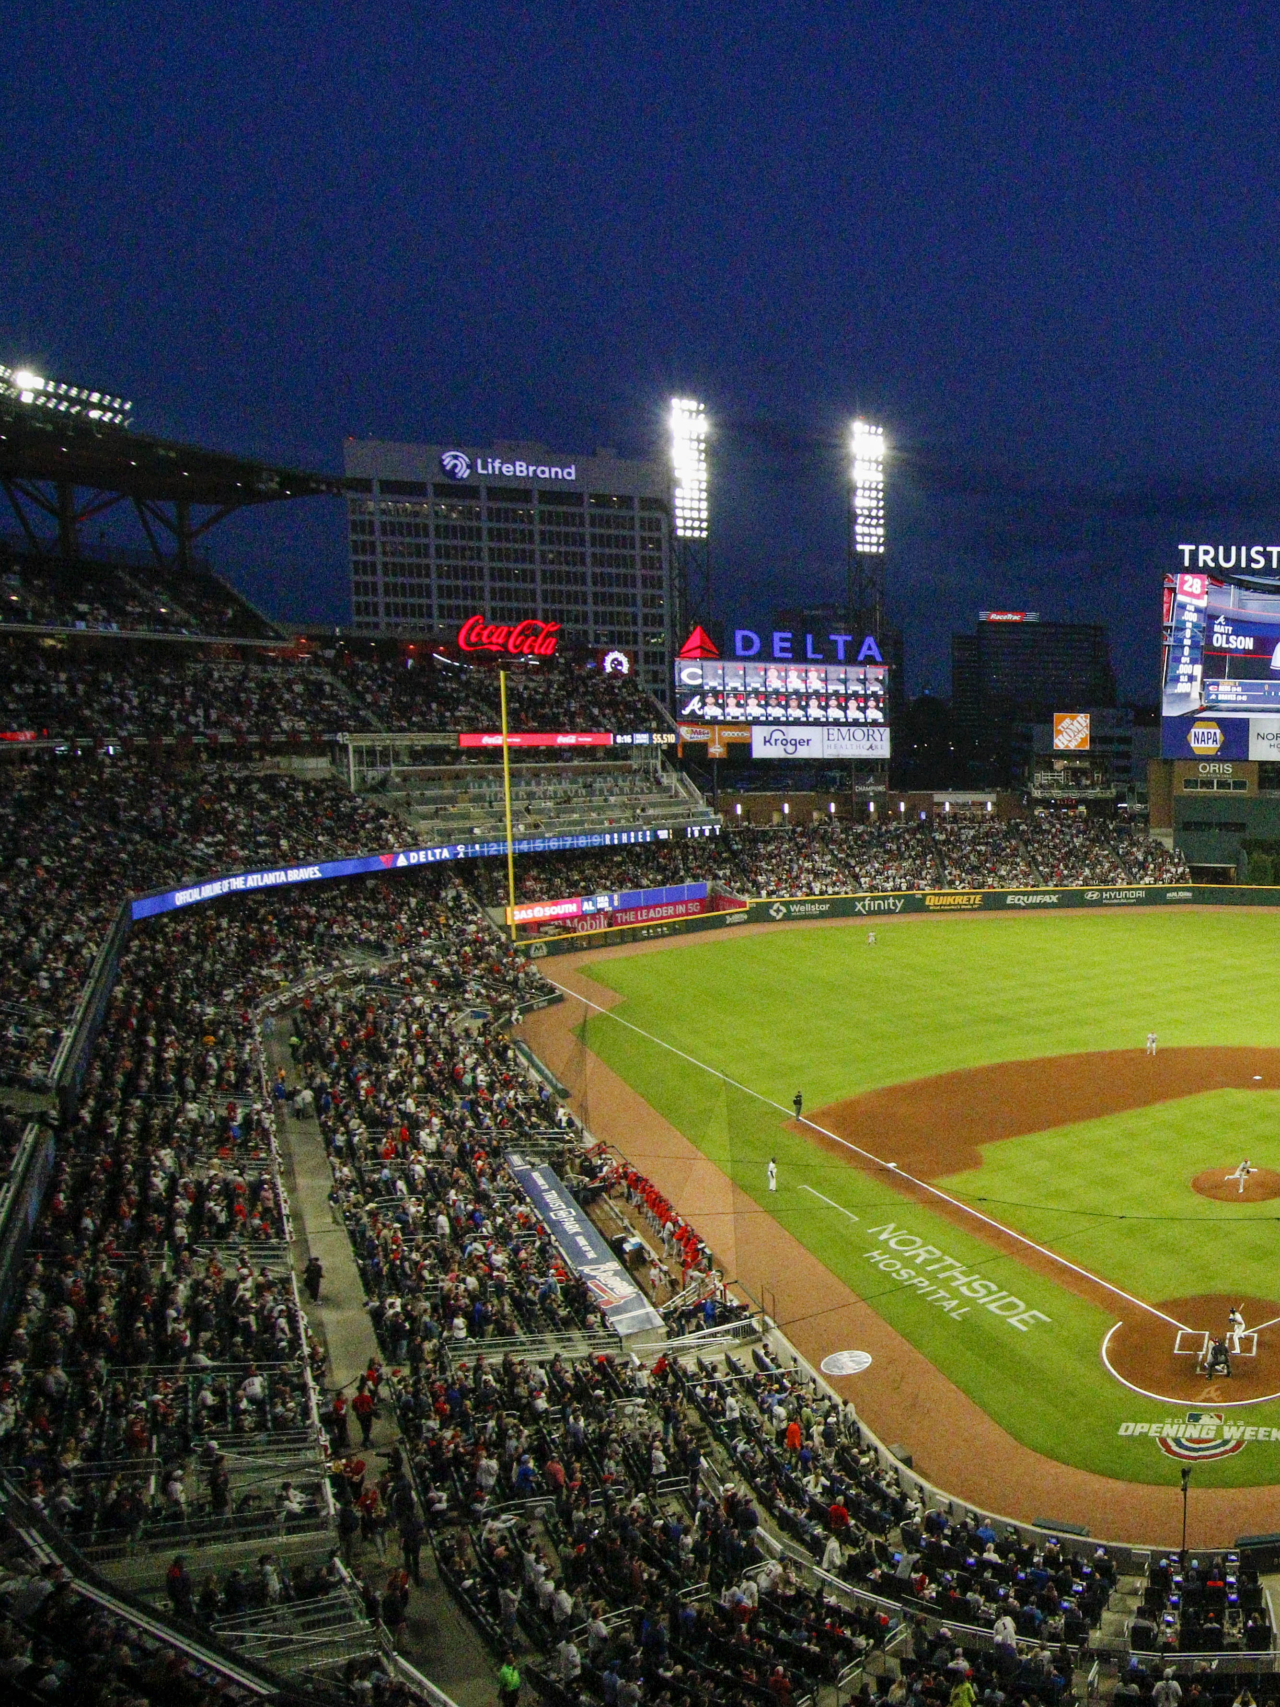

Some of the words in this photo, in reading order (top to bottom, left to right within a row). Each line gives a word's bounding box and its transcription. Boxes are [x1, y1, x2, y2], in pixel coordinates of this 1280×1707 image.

[476, 458, 576, 481] LifeBrand
[1182, 575, 1202, 594] 28
[990, 613, 1021, 621] RaceTrac
[1182, 611, 1198, 622] .000
[458, 615, 562, 655] Coca-Cola
[1214, 625, 1233, 634] MATT
[734, 629, 883, 662] DELTA
[1212, 634, 1254, 650] OLSON
[1054, 715, 1089, 749] HOME
[1057, 717, 1074, 731] THE
[616, 734, 632, 744] 8:16
[652, 733, 675, 745] $5,510
[763, 728, 812, 755] Kroger
[826, 728, 886, 742] EMORY
[1068, 727, 1089, 749] DEPOT
[1194, 731, 1218, 746] NAPA
[1199, 763, 1232, 773] ORIS
[605, 833, 611, 845] R
[622, 832, 628, 843] H
[409, 848, 450, 864] DELTA
[175, 888, 202, 905] OFFICIAL
[222, 881, 230, 893] OF
[230, 876, 245, 890] THE
[246, 870, 287, 888] ATLANTA
[287, 866, 322, 882] BRAVES.
[925, 894, 983, 906] QUIKRETE
[1006, 894, 1059, 906] EQUIFAX
[1102, 890, 1146, 899] HYUNDAI
[545, 903, 577, 916] SOUTH
[582, 901, 595, 911] AL
[616, 912, 635, 923] THE
[638, 905, 674, 920] LEADER
[676, 904, 686, 915] IN
[688, 902, 700, 913] 5G
[789, 903, 830, 912] Wellstar
[855, 896, 905, 914] xfinity
[541, 1190, 567, 1211] TRUIST
[559, 1217, 583, 1234] PARK
[578, 1261, 638, 1295] Braves
[866, 1222, 1052, 1331] NORTHSIDE
[862, 1250, 971, 1321] HOSPITAL
[1118, 1422, 1217, 1439] OPENING
